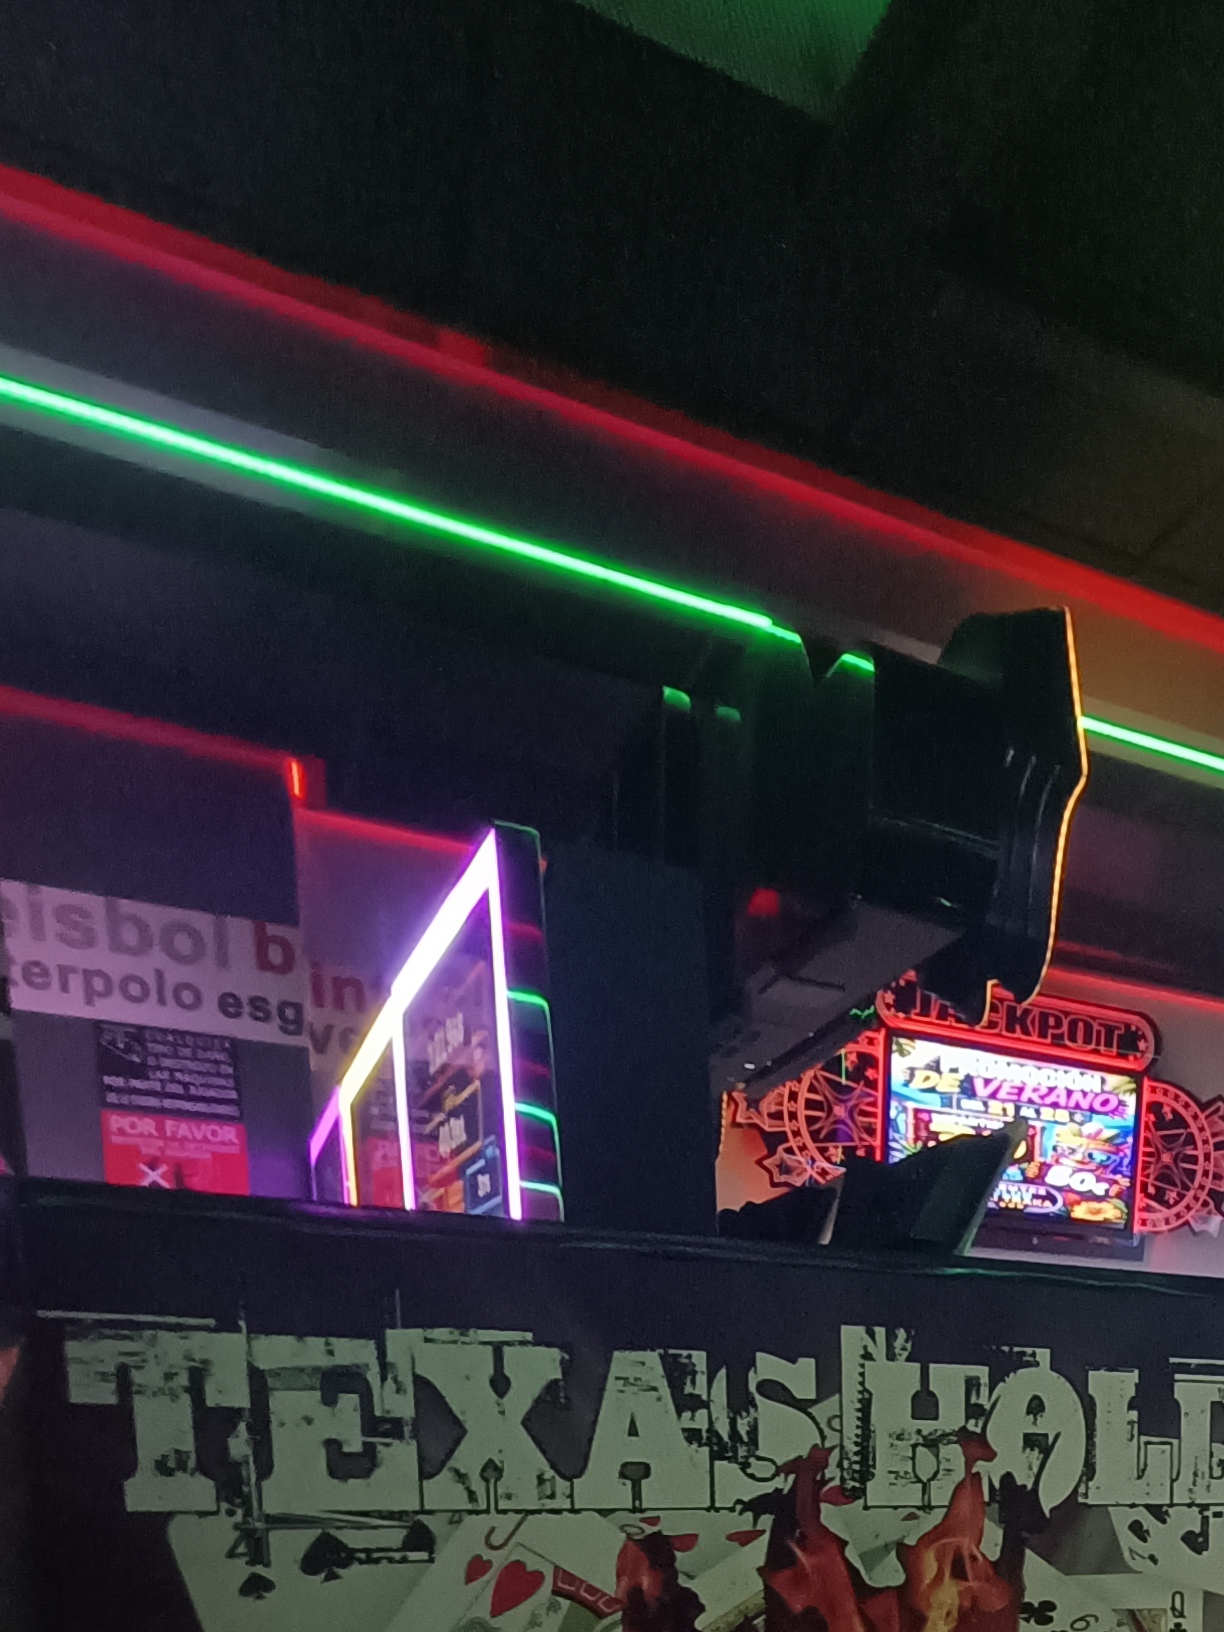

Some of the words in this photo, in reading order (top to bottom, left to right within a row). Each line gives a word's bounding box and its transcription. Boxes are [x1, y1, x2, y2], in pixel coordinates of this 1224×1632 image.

[909, 1069, 962, 1094] DE
[971, 1077, 1119, 1113] VERANO
[110, 1114, 159, 1137] POR
[165, 1119, 240, 1144] FAVOR
[64, 1325, 822, 1512] TEXAS
